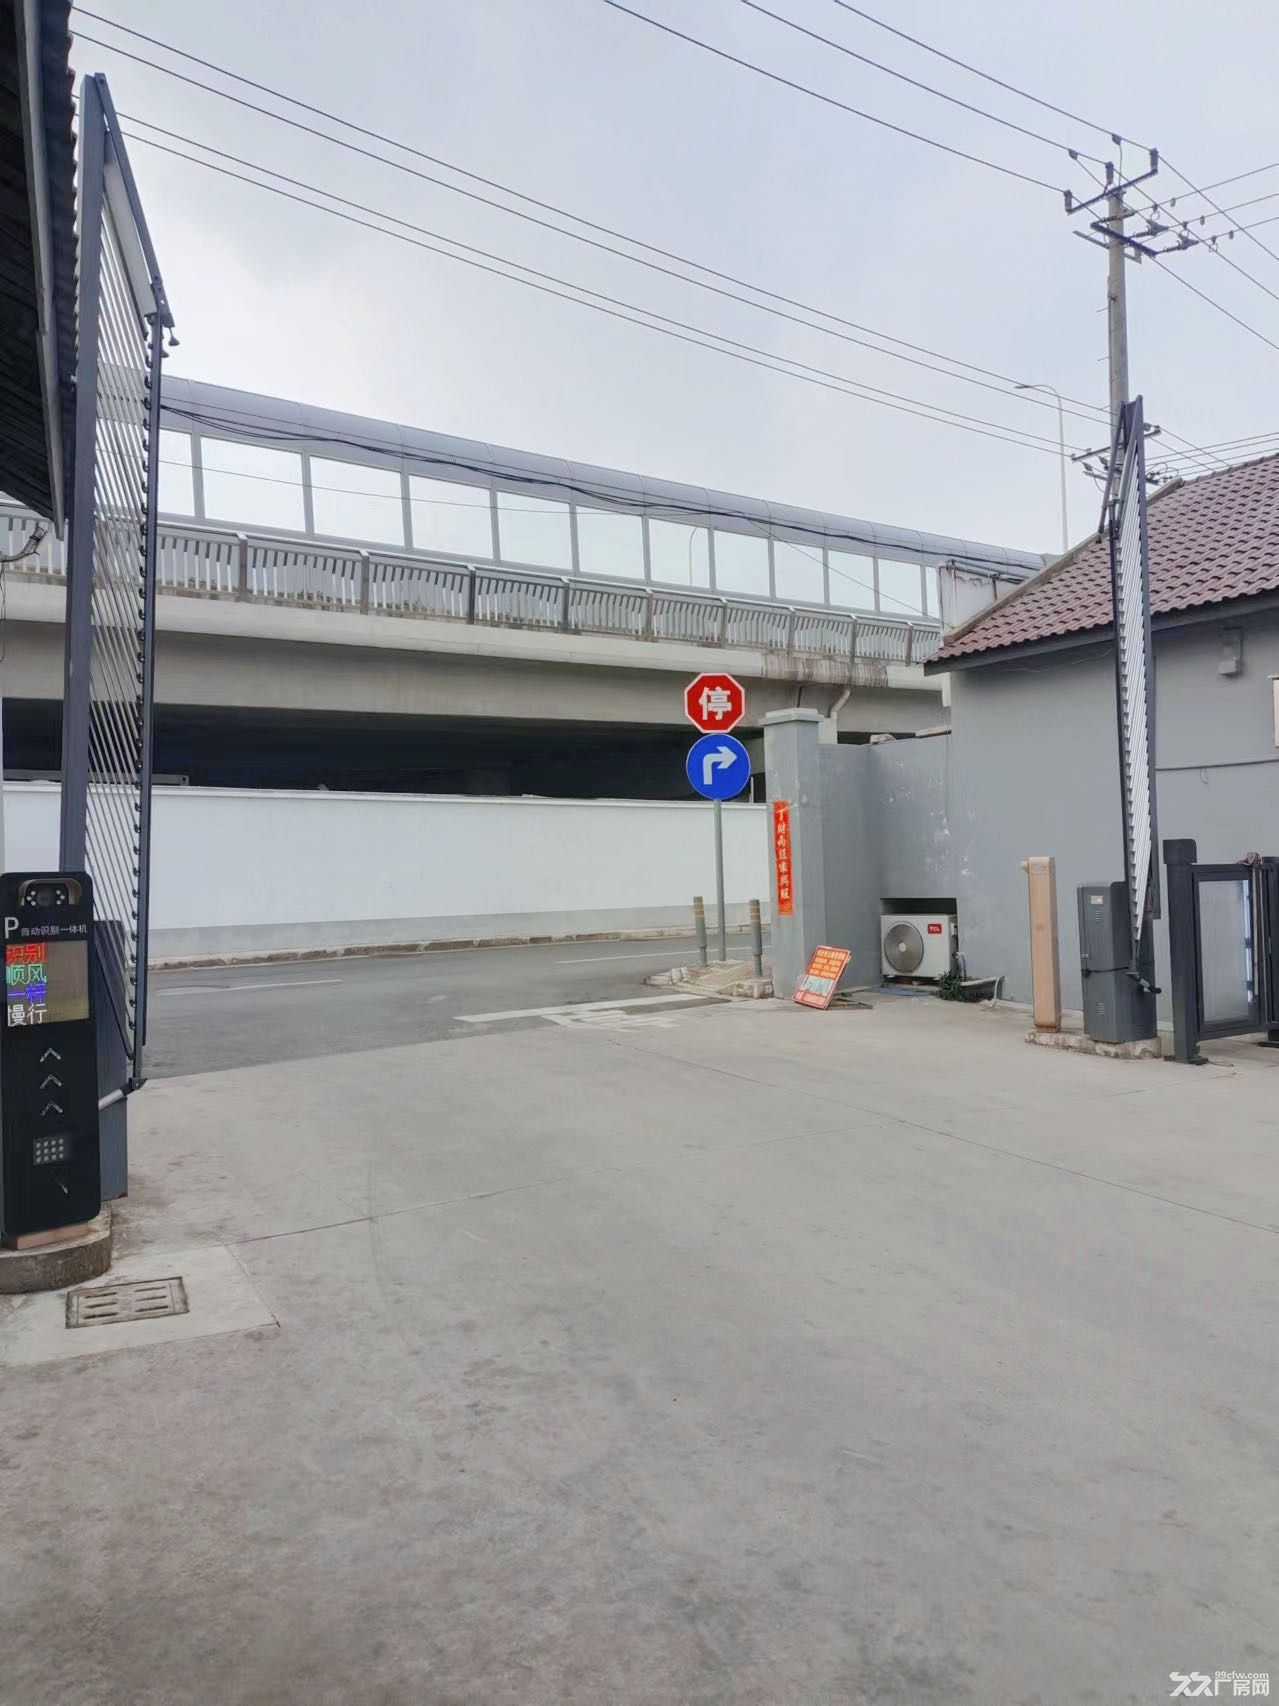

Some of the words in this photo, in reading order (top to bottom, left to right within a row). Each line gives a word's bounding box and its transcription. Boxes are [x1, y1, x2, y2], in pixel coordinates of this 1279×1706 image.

[698, 686, 732, 720] 停
[4, 916, 20, 939] P
[21, 924, 88, 936] 自动识别一体机
[6, 942, 46, 965] 识别
[6, 964, 47, 986] 顺风
[7, 983, 47, 1005] 一杆
[7, 1003, 47, 1027] 慢行
